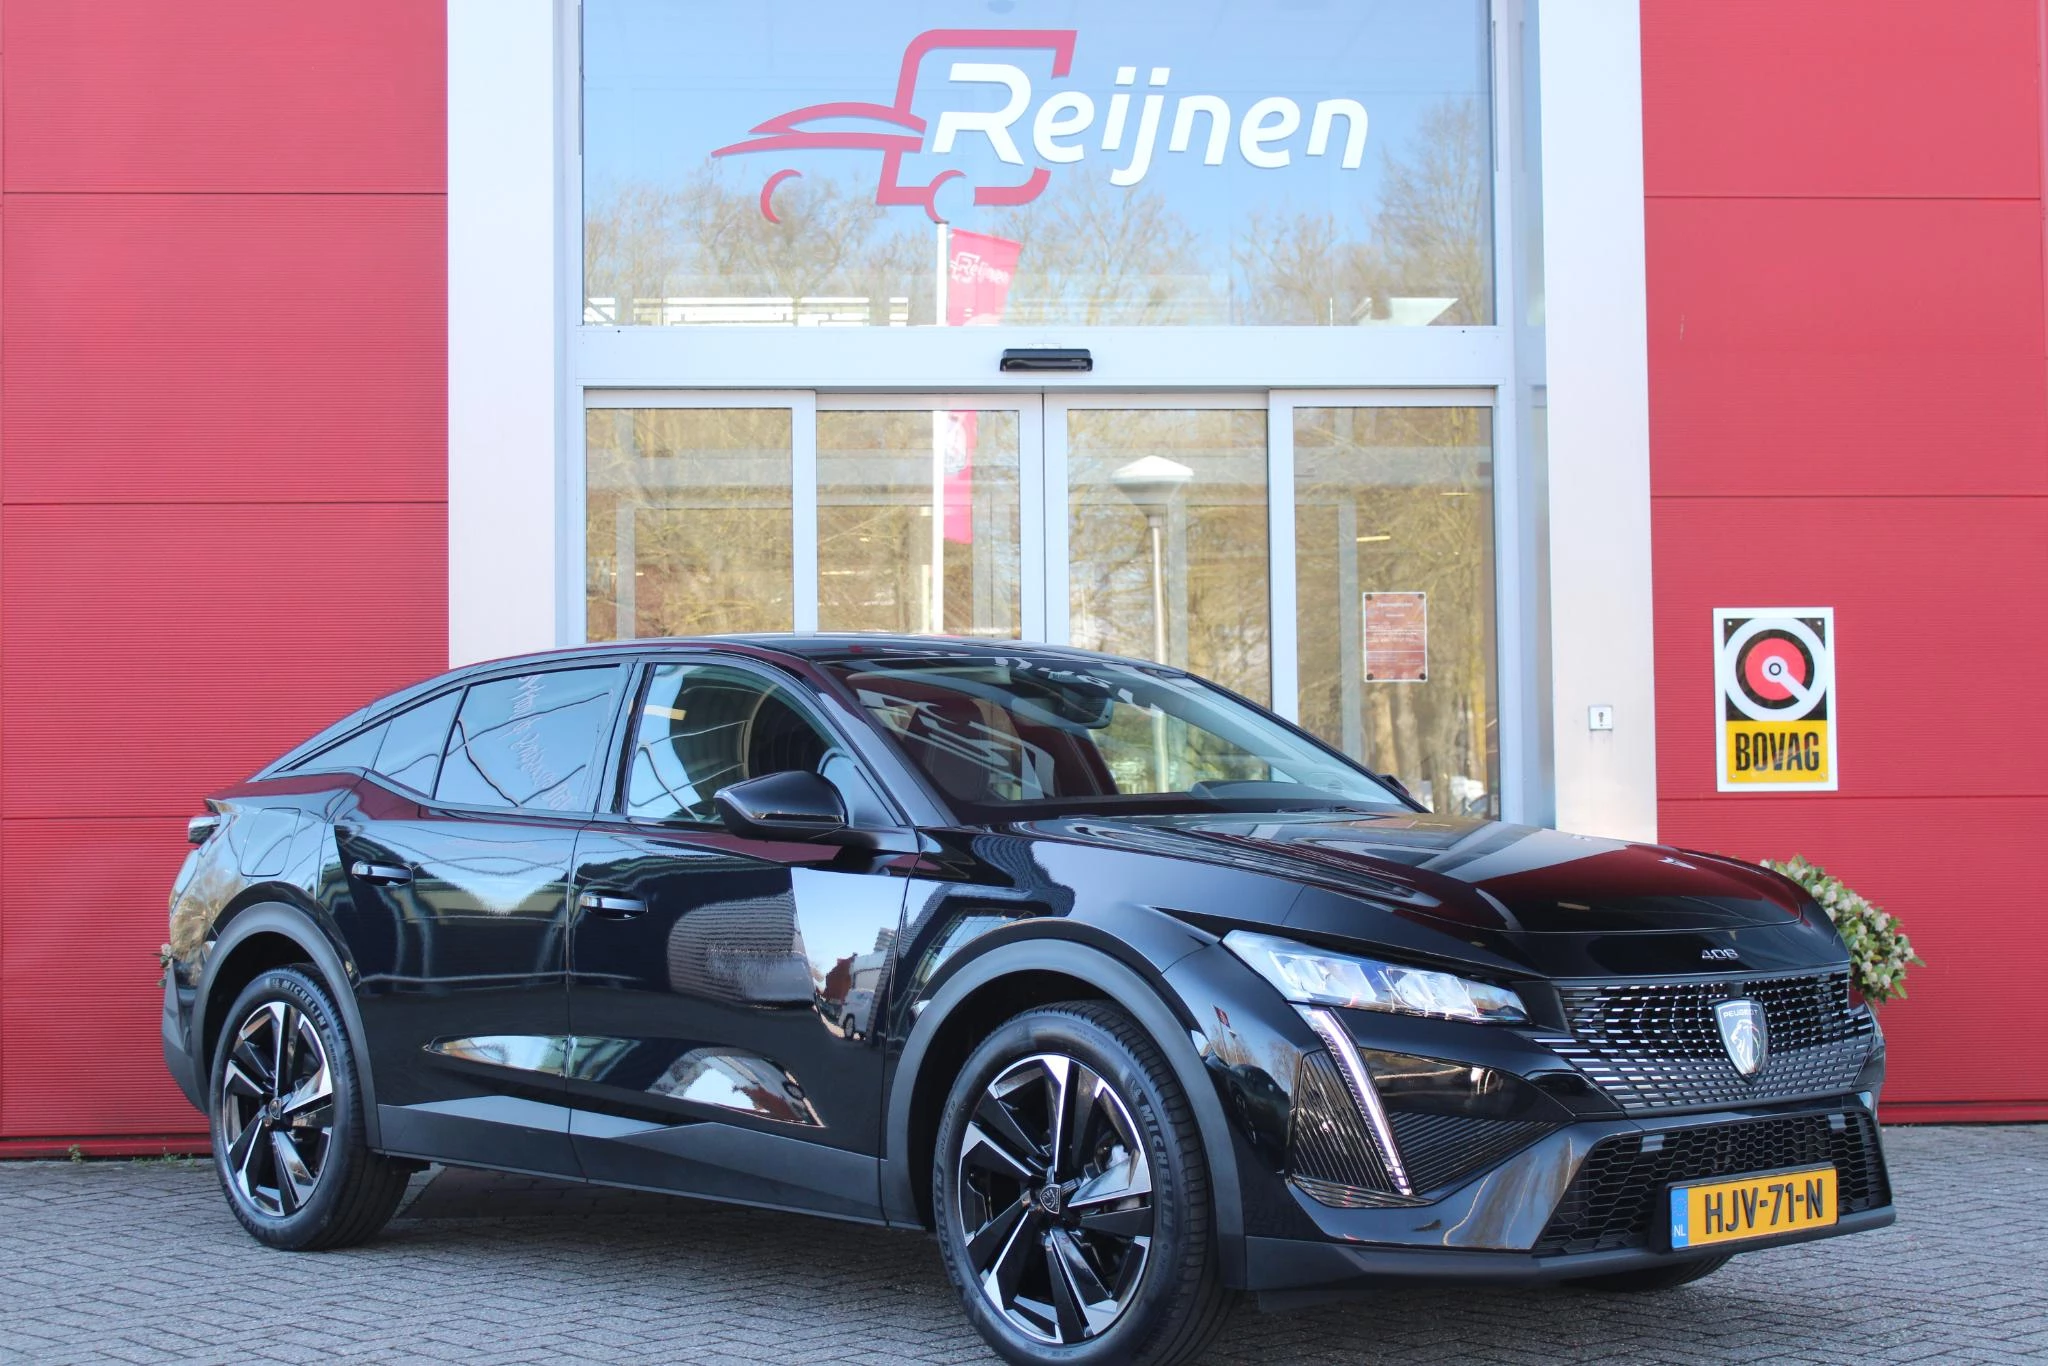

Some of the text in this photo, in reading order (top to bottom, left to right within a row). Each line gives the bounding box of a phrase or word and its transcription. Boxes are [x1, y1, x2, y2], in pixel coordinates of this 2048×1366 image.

[931, 62, 1369, 187] Reijnen
[1735, 731, 1820, 772] BOVAG
[282, 980, 326, 1027] MICHELIN
[1140, 1103, 1173, 1231] MICHELIN
[1673, 1225, 1687, 1237] NL
[1705, 1178, 1823, 1234] HJV-71-N
